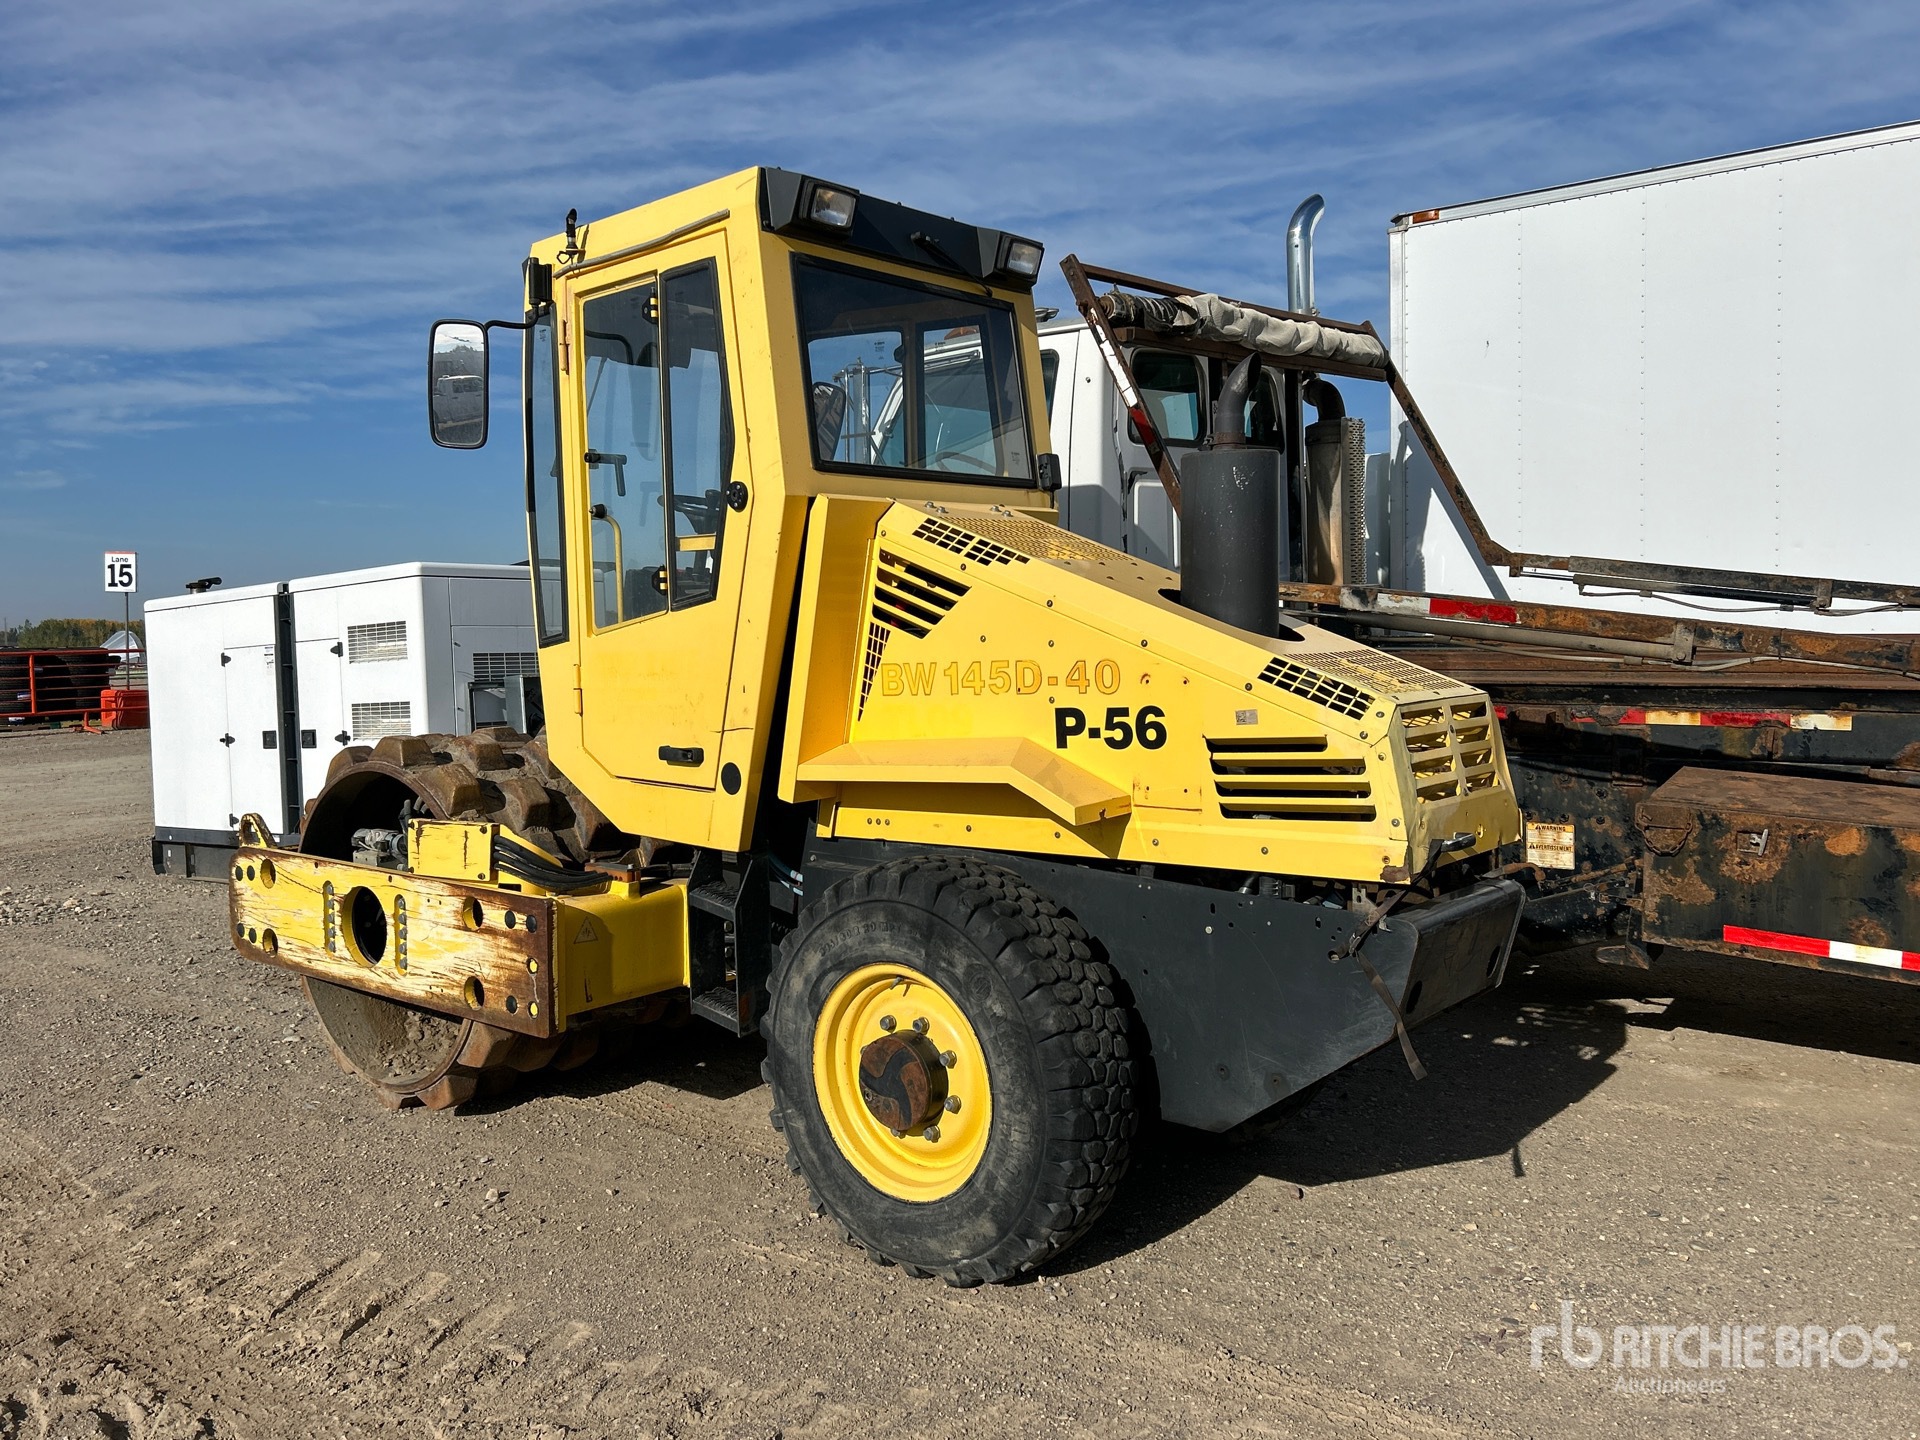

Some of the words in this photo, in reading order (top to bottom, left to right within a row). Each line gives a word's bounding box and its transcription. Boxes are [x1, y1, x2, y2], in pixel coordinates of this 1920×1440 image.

[107, 563, 133, 587] 15
[880, 661, 936, 696] BW
[943, 659, 1121, 696] 145D-40
[1054, 705, 1167, 750] P-56
